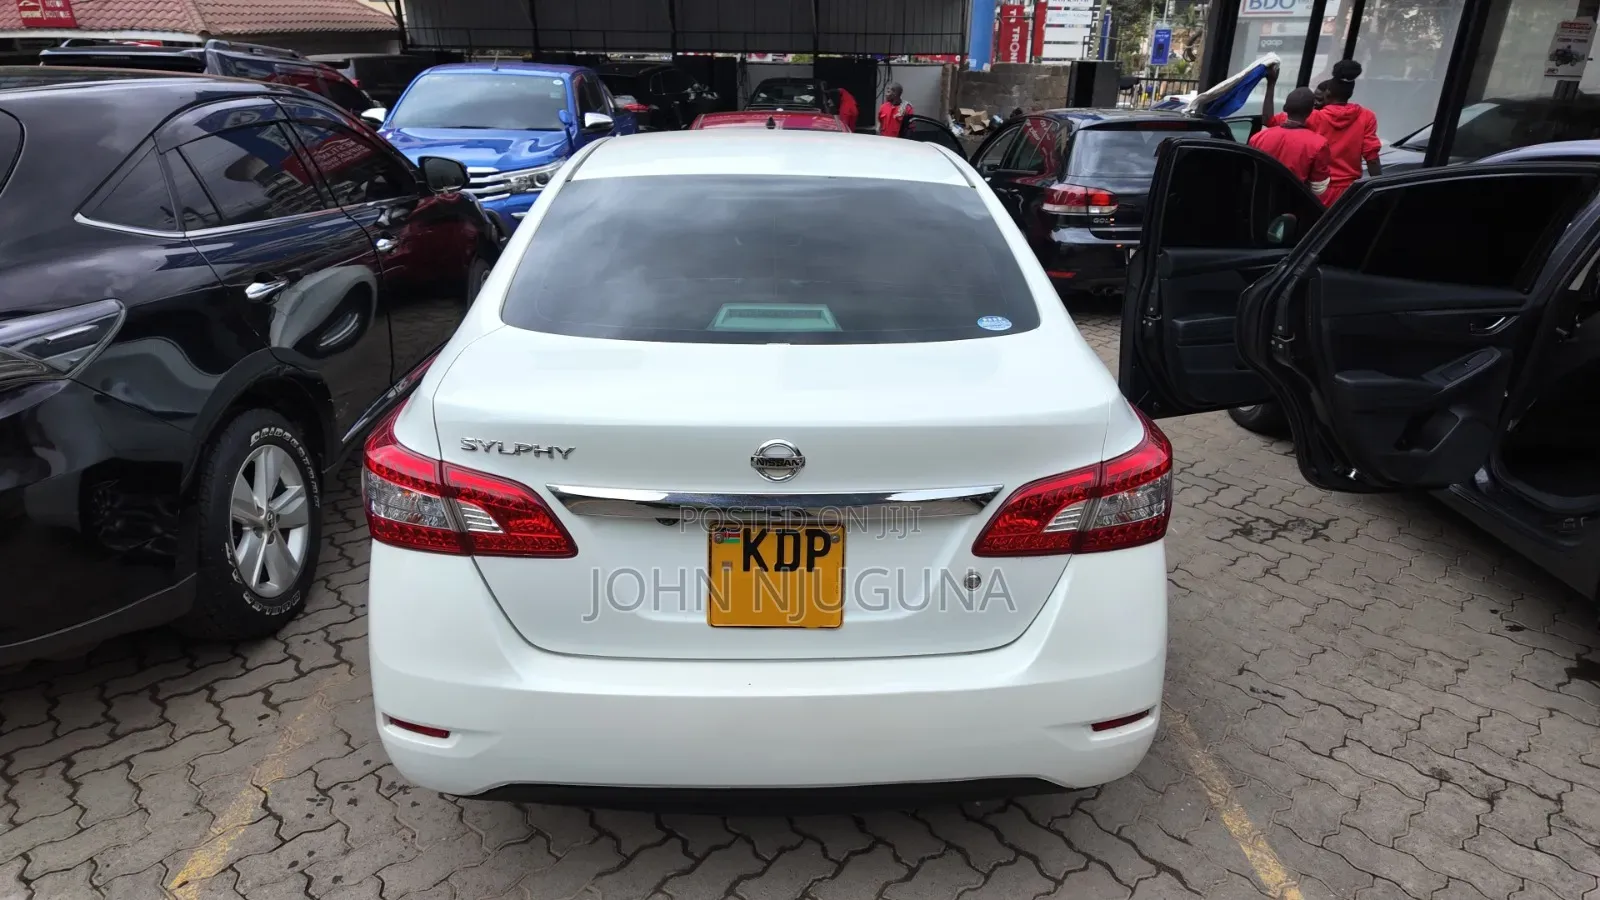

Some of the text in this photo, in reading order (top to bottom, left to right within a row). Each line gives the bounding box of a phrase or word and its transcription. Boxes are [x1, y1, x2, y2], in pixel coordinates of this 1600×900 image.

[1248, 0, 1295, 10] BDO
[460, 437, 576, 460] SYLPHY
[756, 458, 801, 467] NISSAN
[742, 527, 832, 573] KDP
